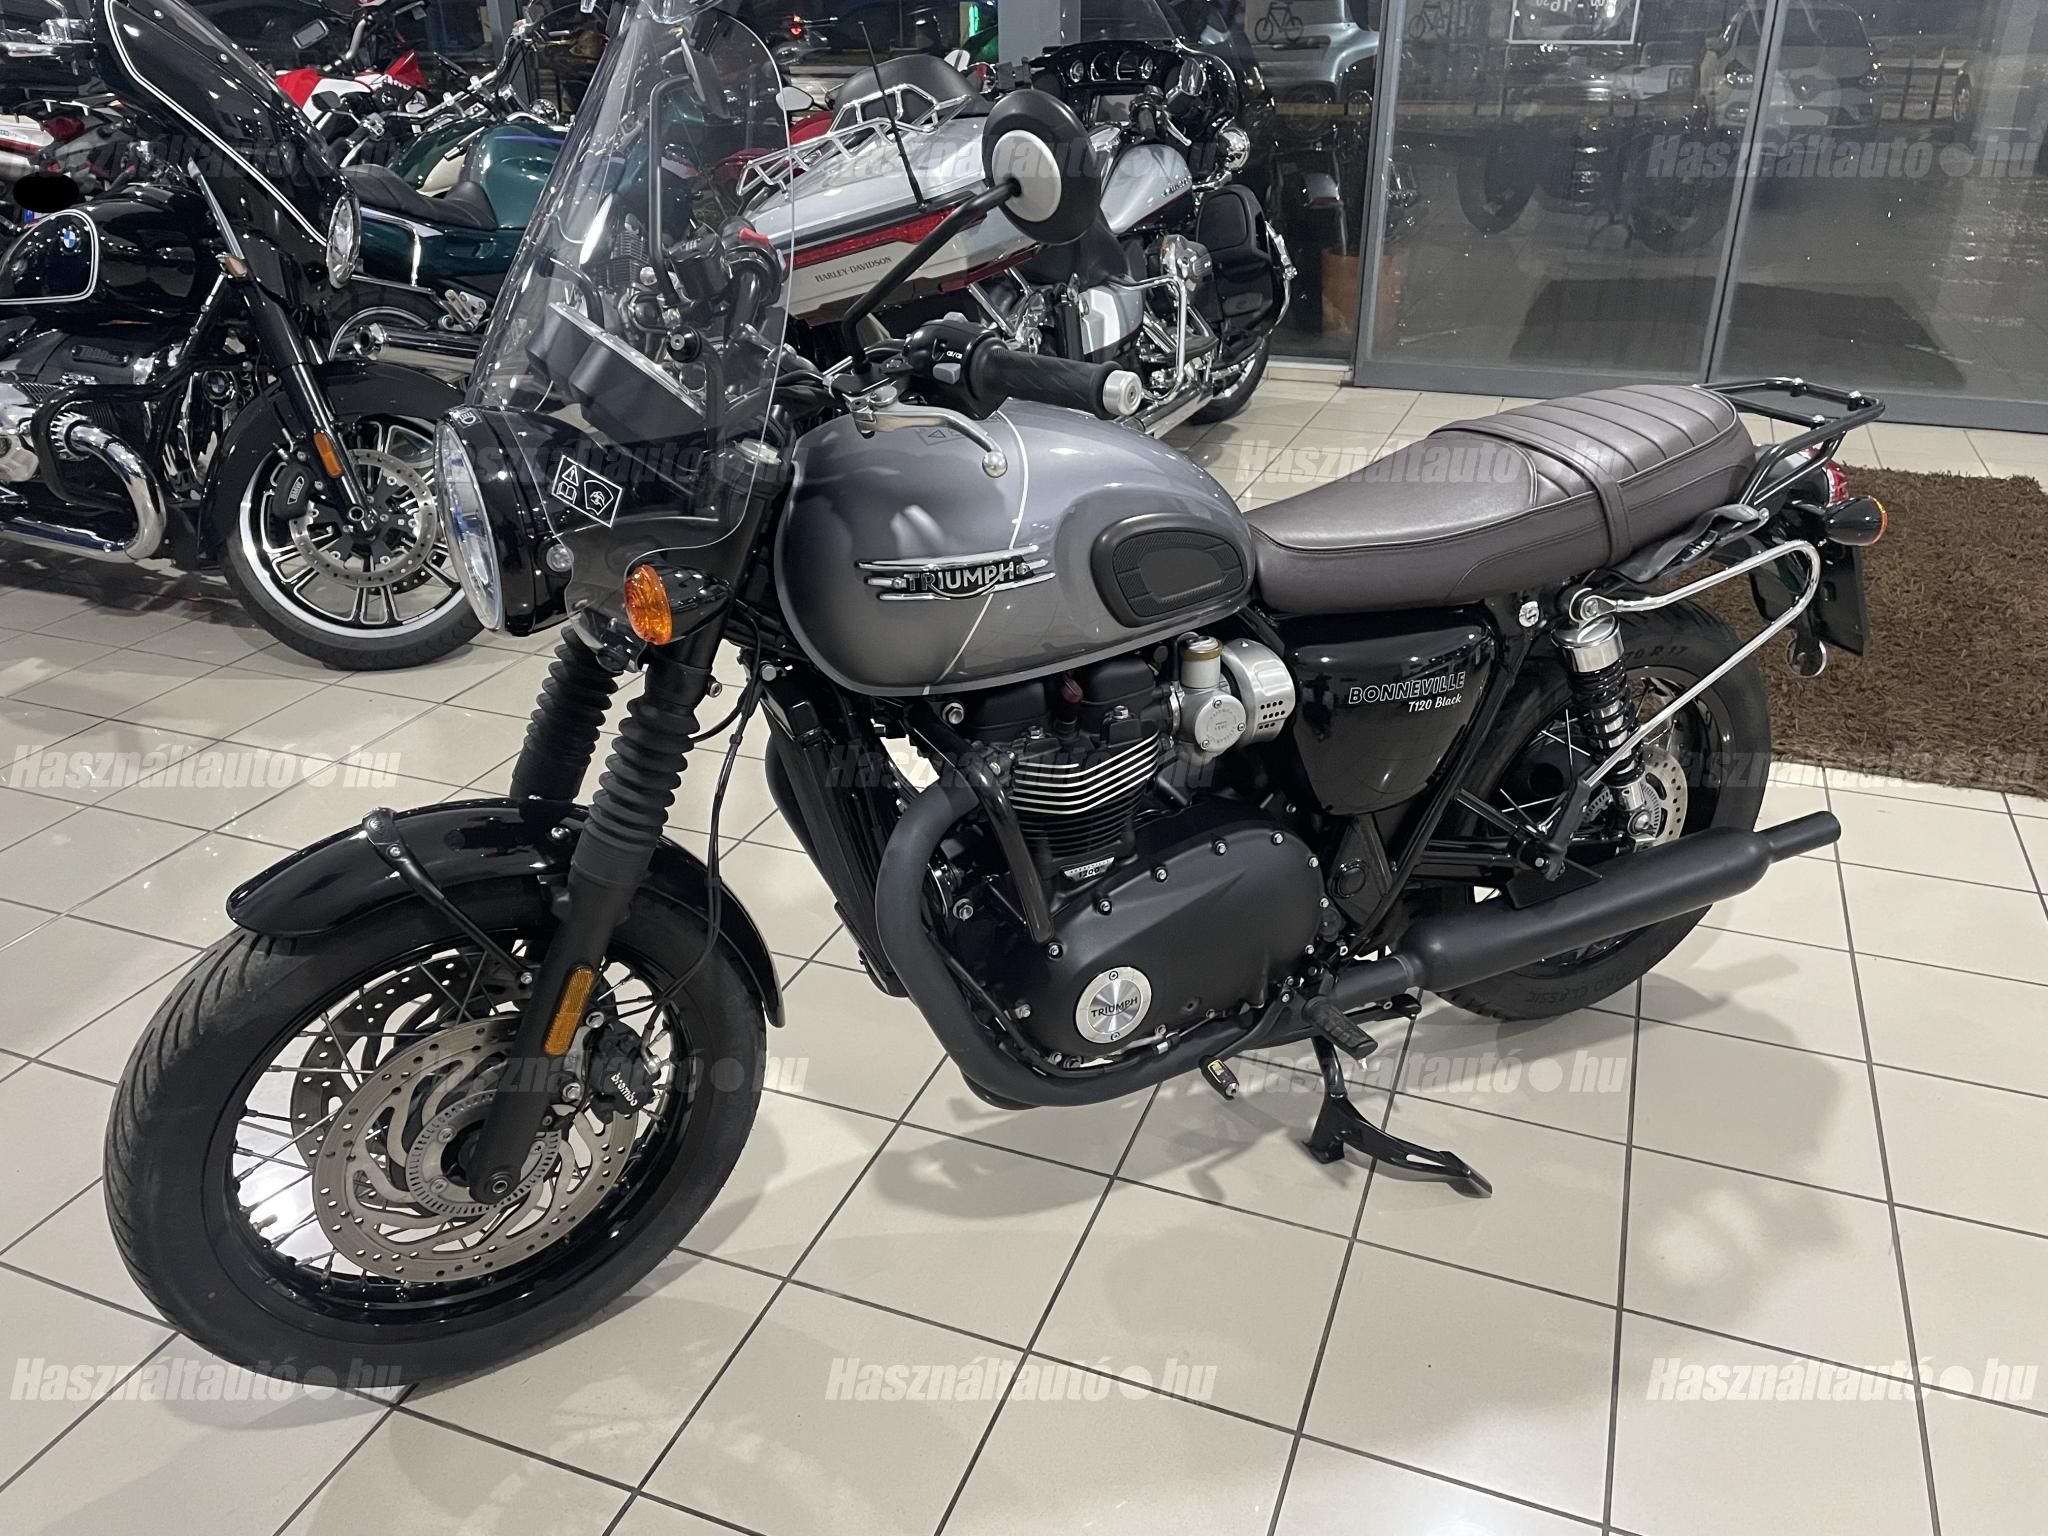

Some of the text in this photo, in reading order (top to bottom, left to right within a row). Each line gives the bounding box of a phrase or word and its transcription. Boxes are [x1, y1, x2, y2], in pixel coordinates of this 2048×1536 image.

[904, 561, 1014, 597] TRIUMPH
[1348, 671, 1466, 704] BONNEVILLE
[1408, 693, 1462, 712] T120 Black
[1091, 996, 1138, 1017] TRIUMPH
[610, 1072, 638, 1106] brembo
